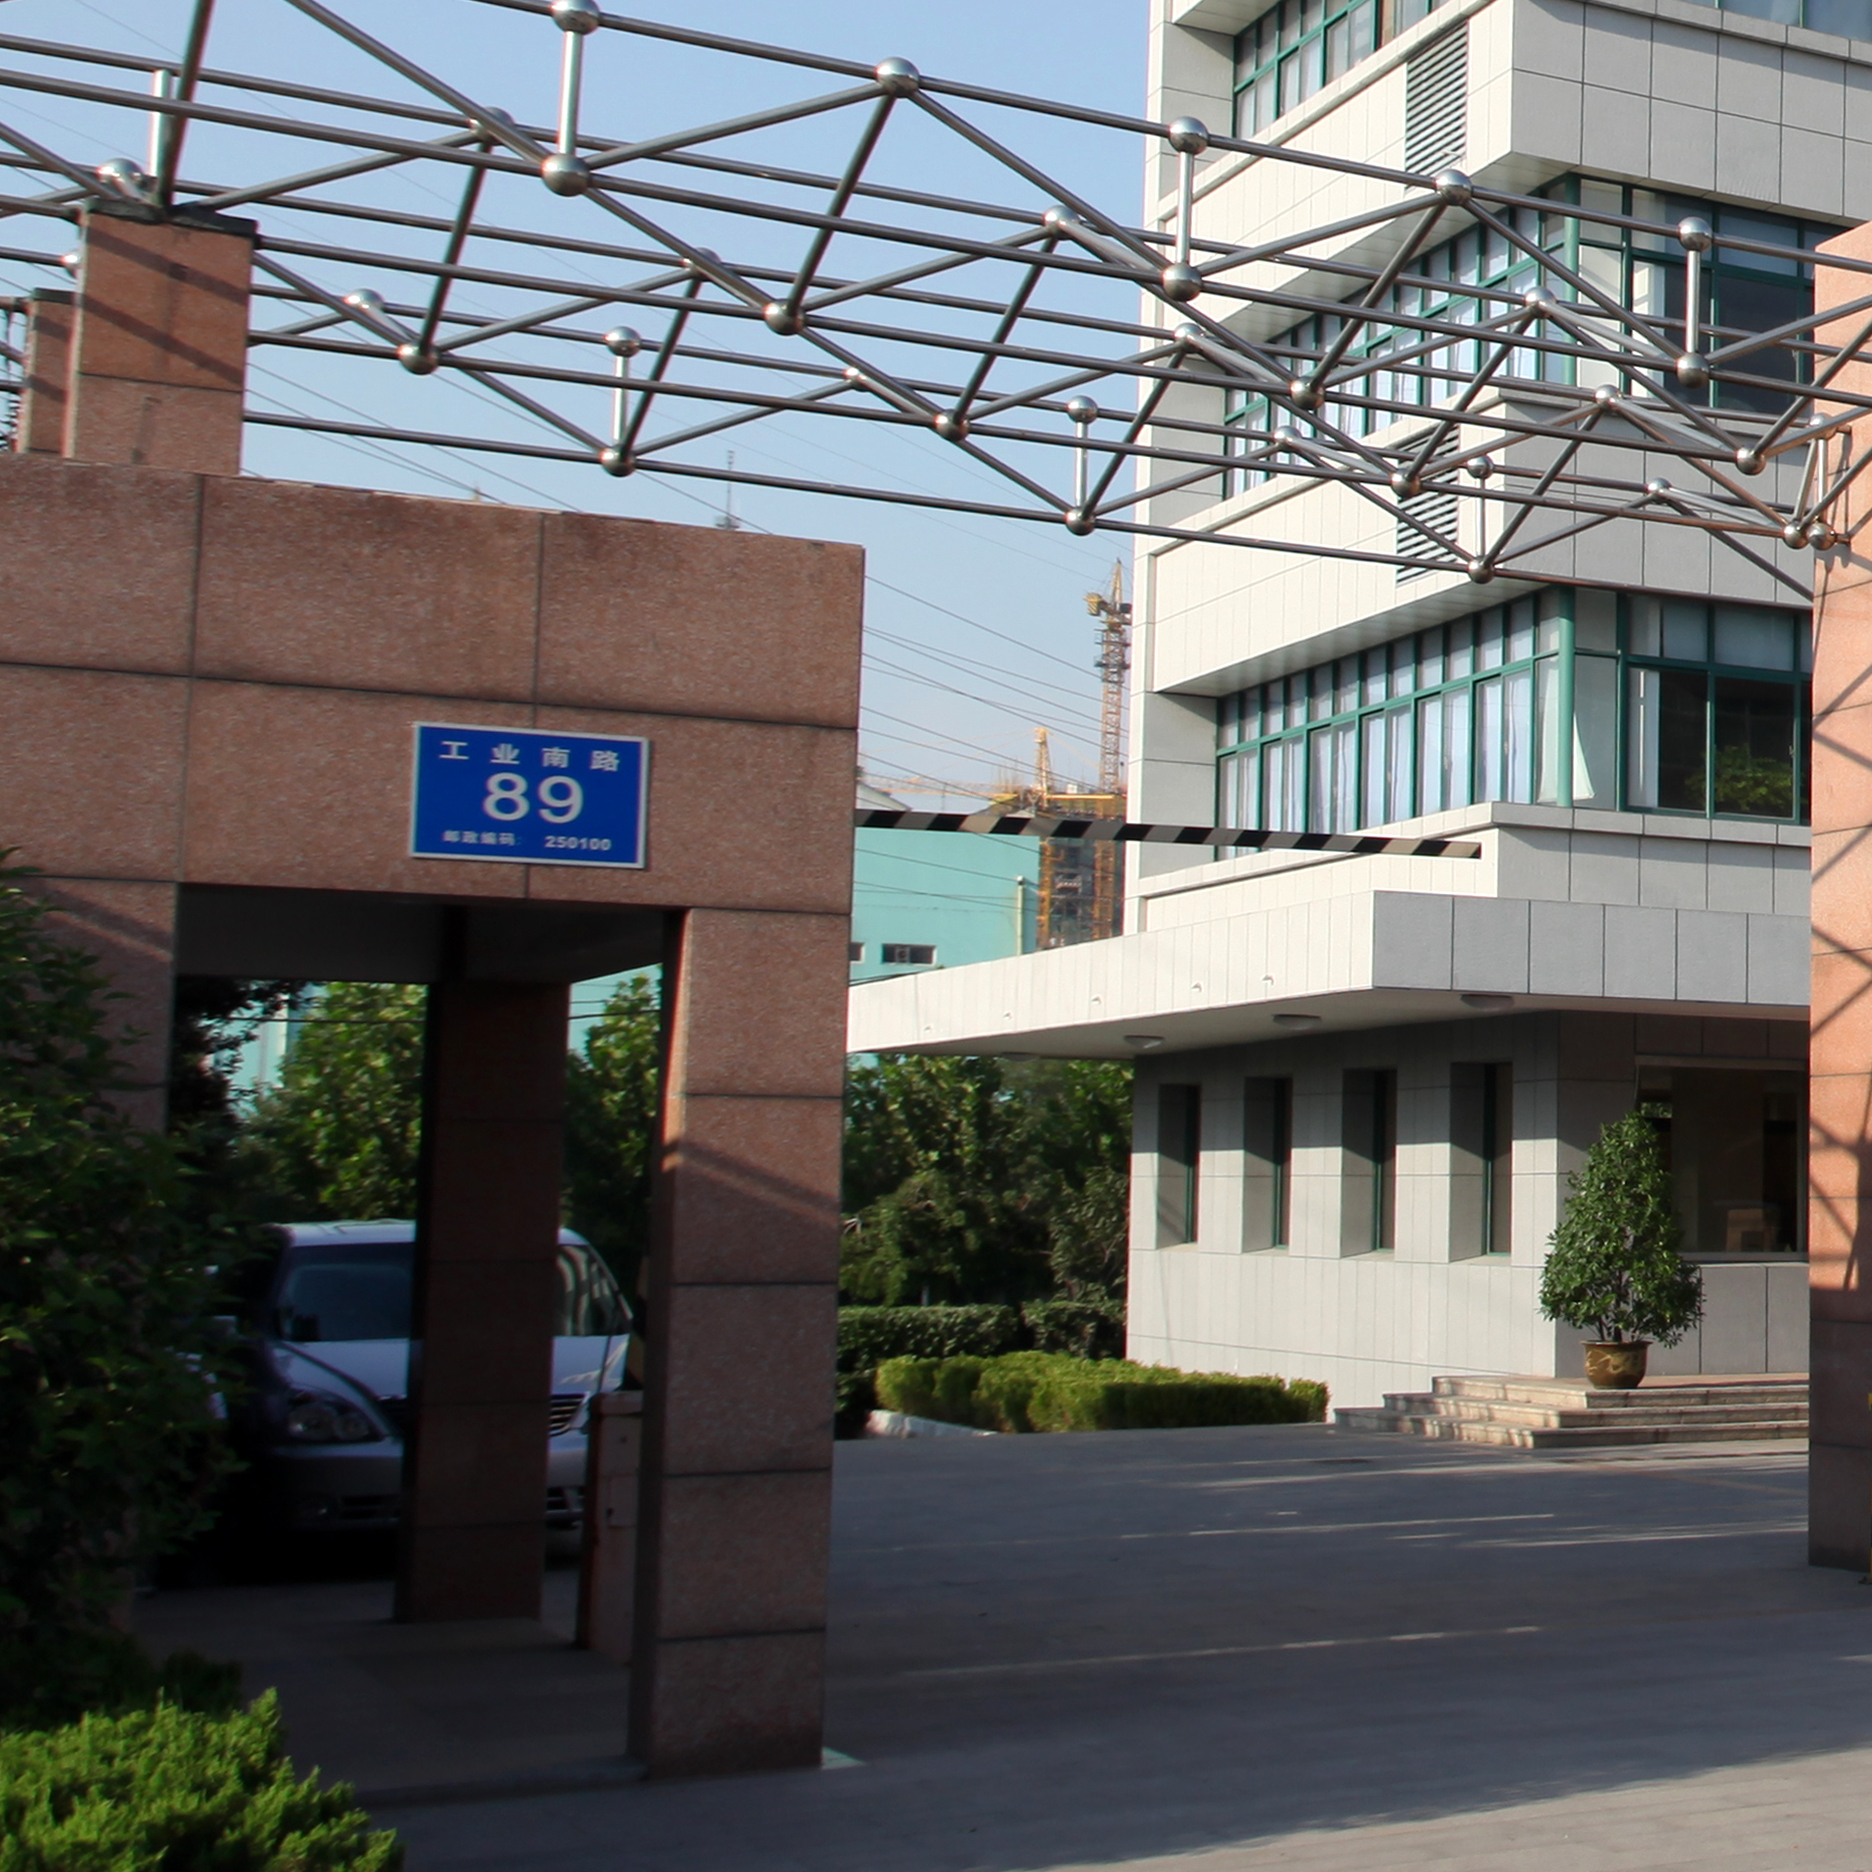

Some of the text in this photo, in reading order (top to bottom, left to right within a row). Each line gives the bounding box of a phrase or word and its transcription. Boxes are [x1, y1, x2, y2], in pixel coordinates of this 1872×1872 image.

[439, 740, 620, 771] 工业南路
[482, 772, 584, 824] 89
[544, 836, 612, 851] 250100
